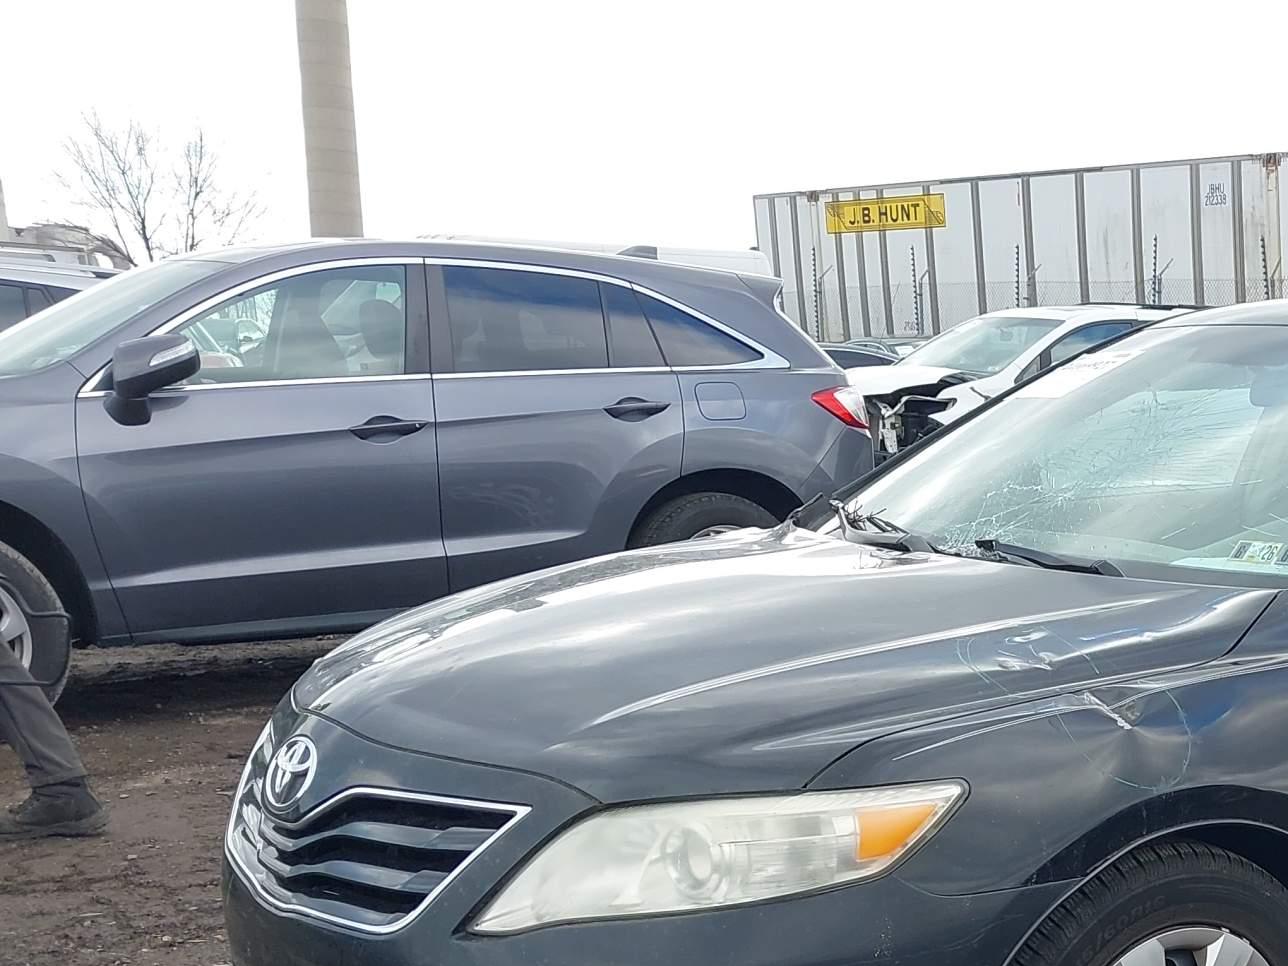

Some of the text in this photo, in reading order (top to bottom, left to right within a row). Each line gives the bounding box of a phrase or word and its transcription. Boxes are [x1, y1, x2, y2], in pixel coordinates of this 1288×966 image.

[848, 203, 920, 225] J.B. HUNT
[1261, 545, 1279, 561] 26
